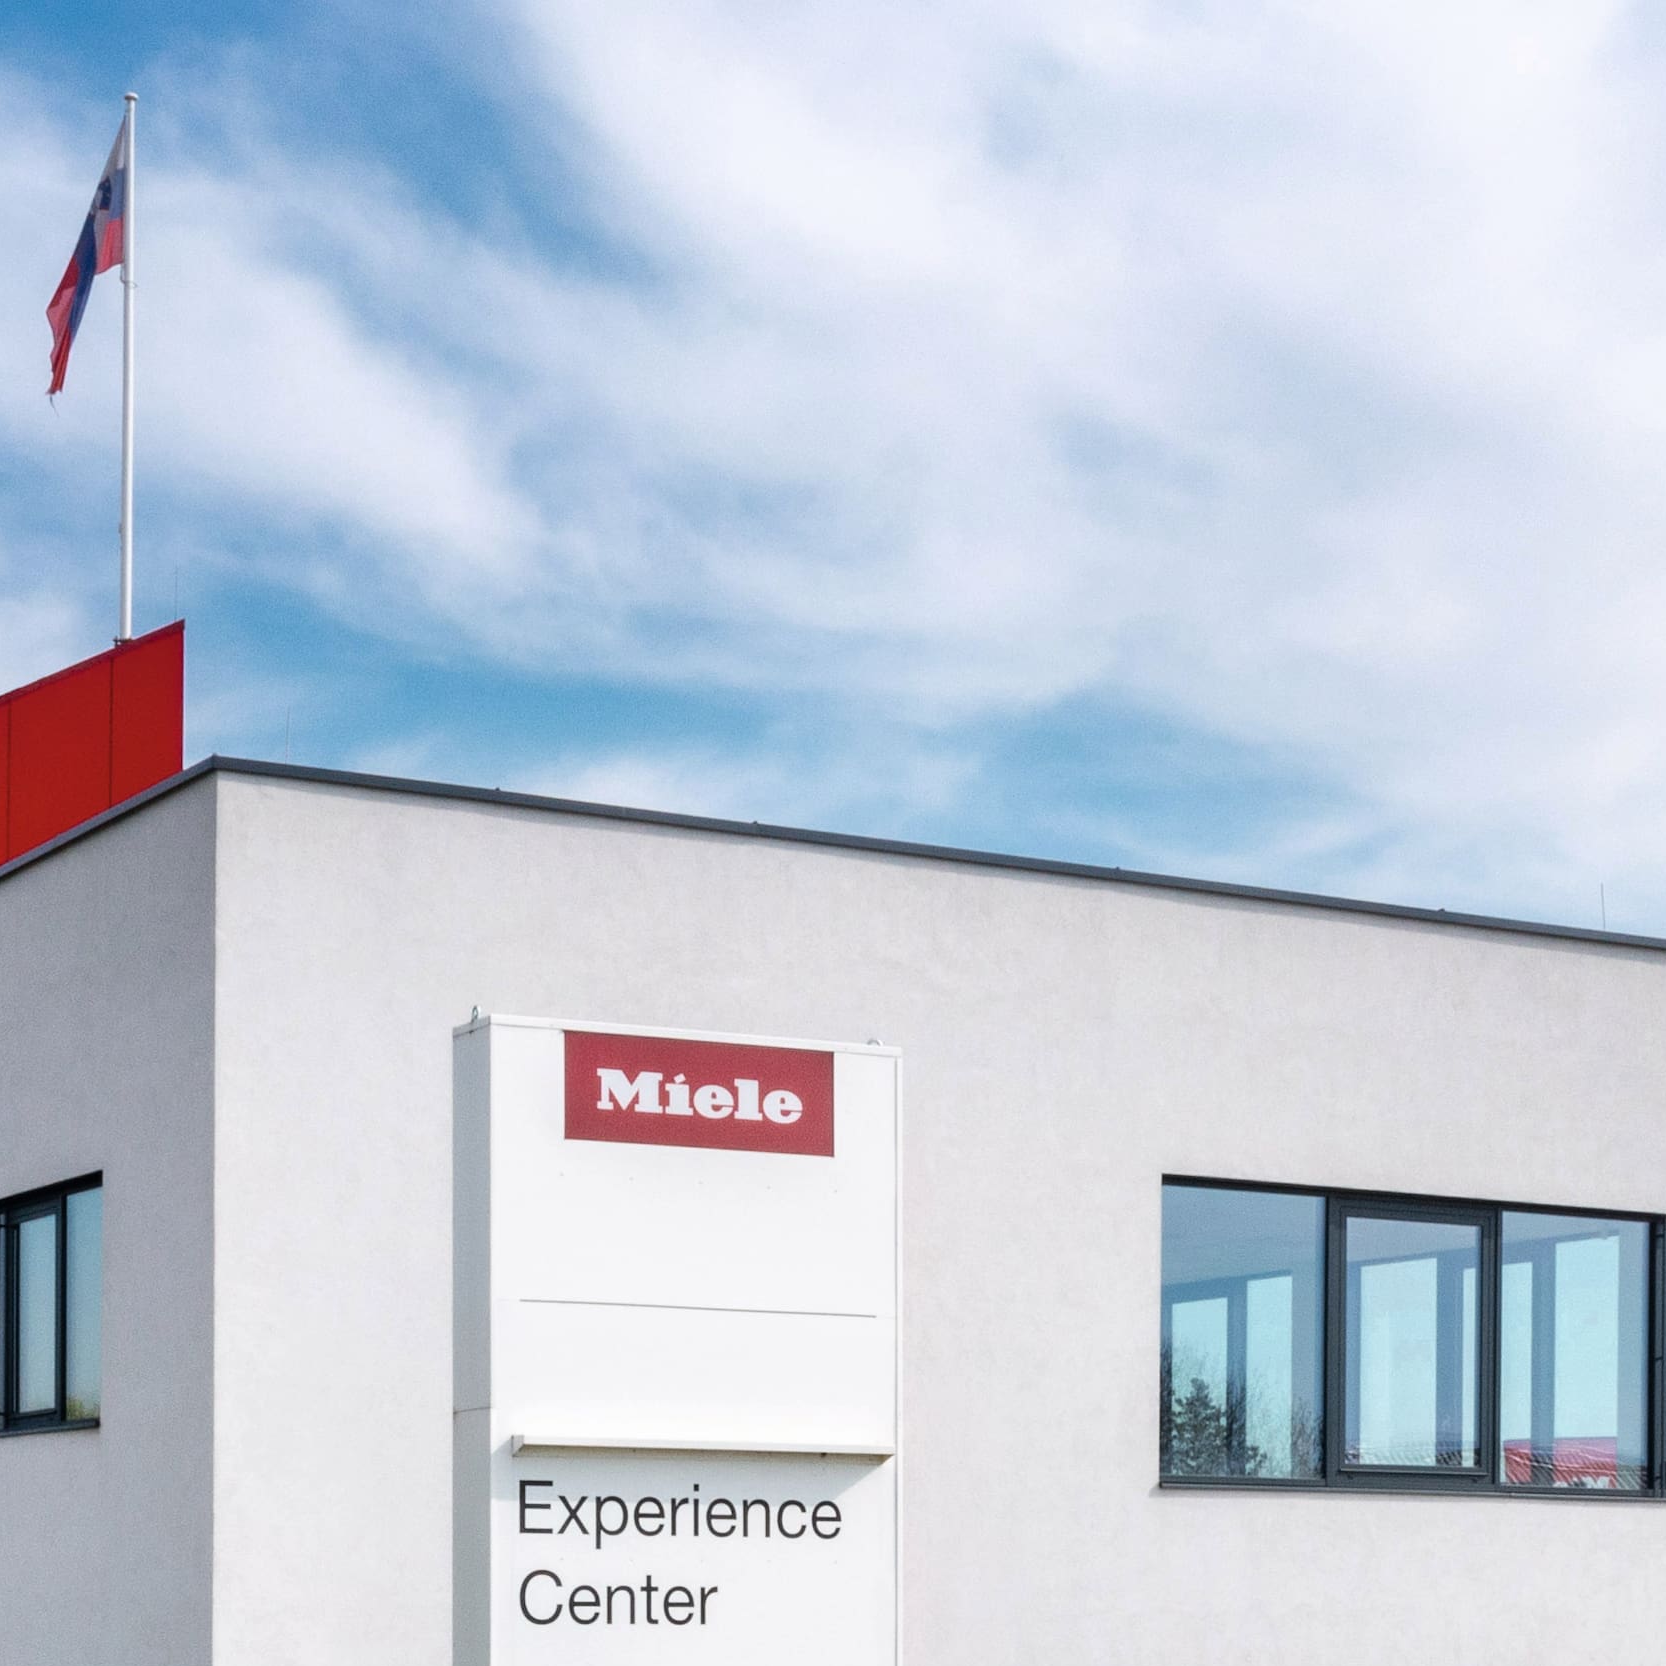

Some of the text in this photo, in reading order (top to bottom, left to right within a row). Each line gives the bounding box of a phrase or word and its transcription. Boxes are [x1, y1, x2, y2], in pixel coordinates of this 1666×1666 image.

[596, 1067, 803, 1125] Miele
[518, 1479, 842, 1550] Experience
[519, 1569, 718, 1626] Center
